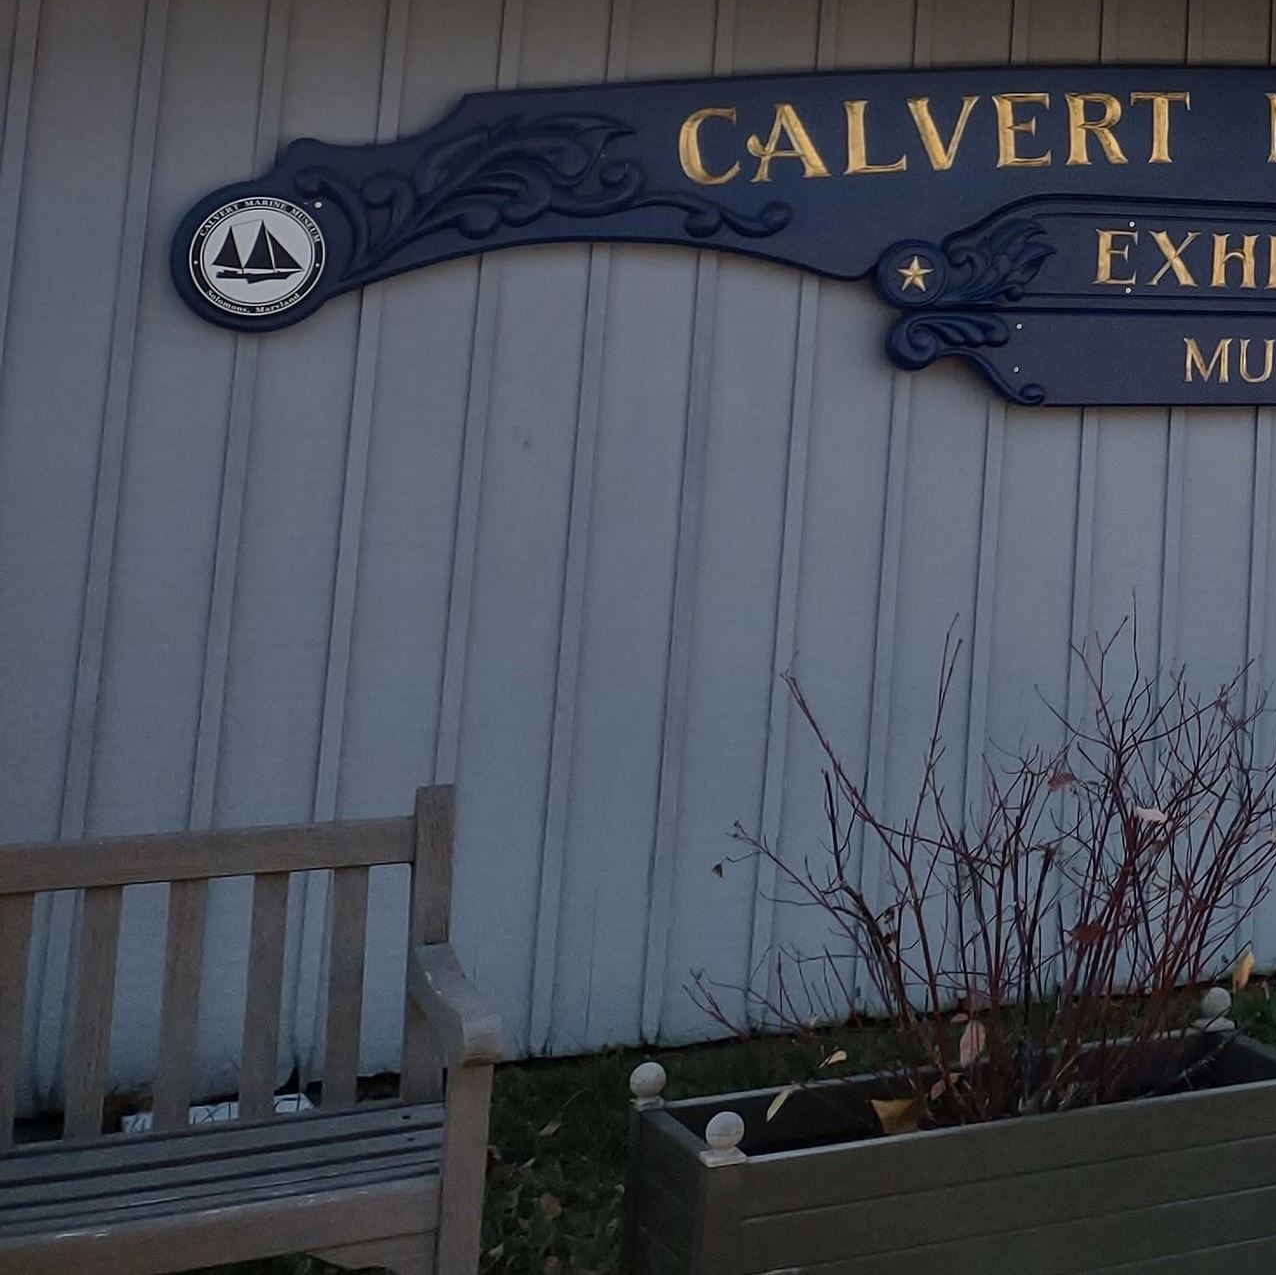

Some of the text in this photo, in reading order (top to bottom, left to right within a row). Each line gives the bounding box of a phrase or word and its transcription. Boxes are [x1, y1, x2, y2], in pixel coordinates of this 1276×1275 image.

[678, 92, 1191, 185] CALVERT
[200, 199, 321, 243] CALVERT MARINE MUSEUM
[255, 292, 300, 313] Maryland
